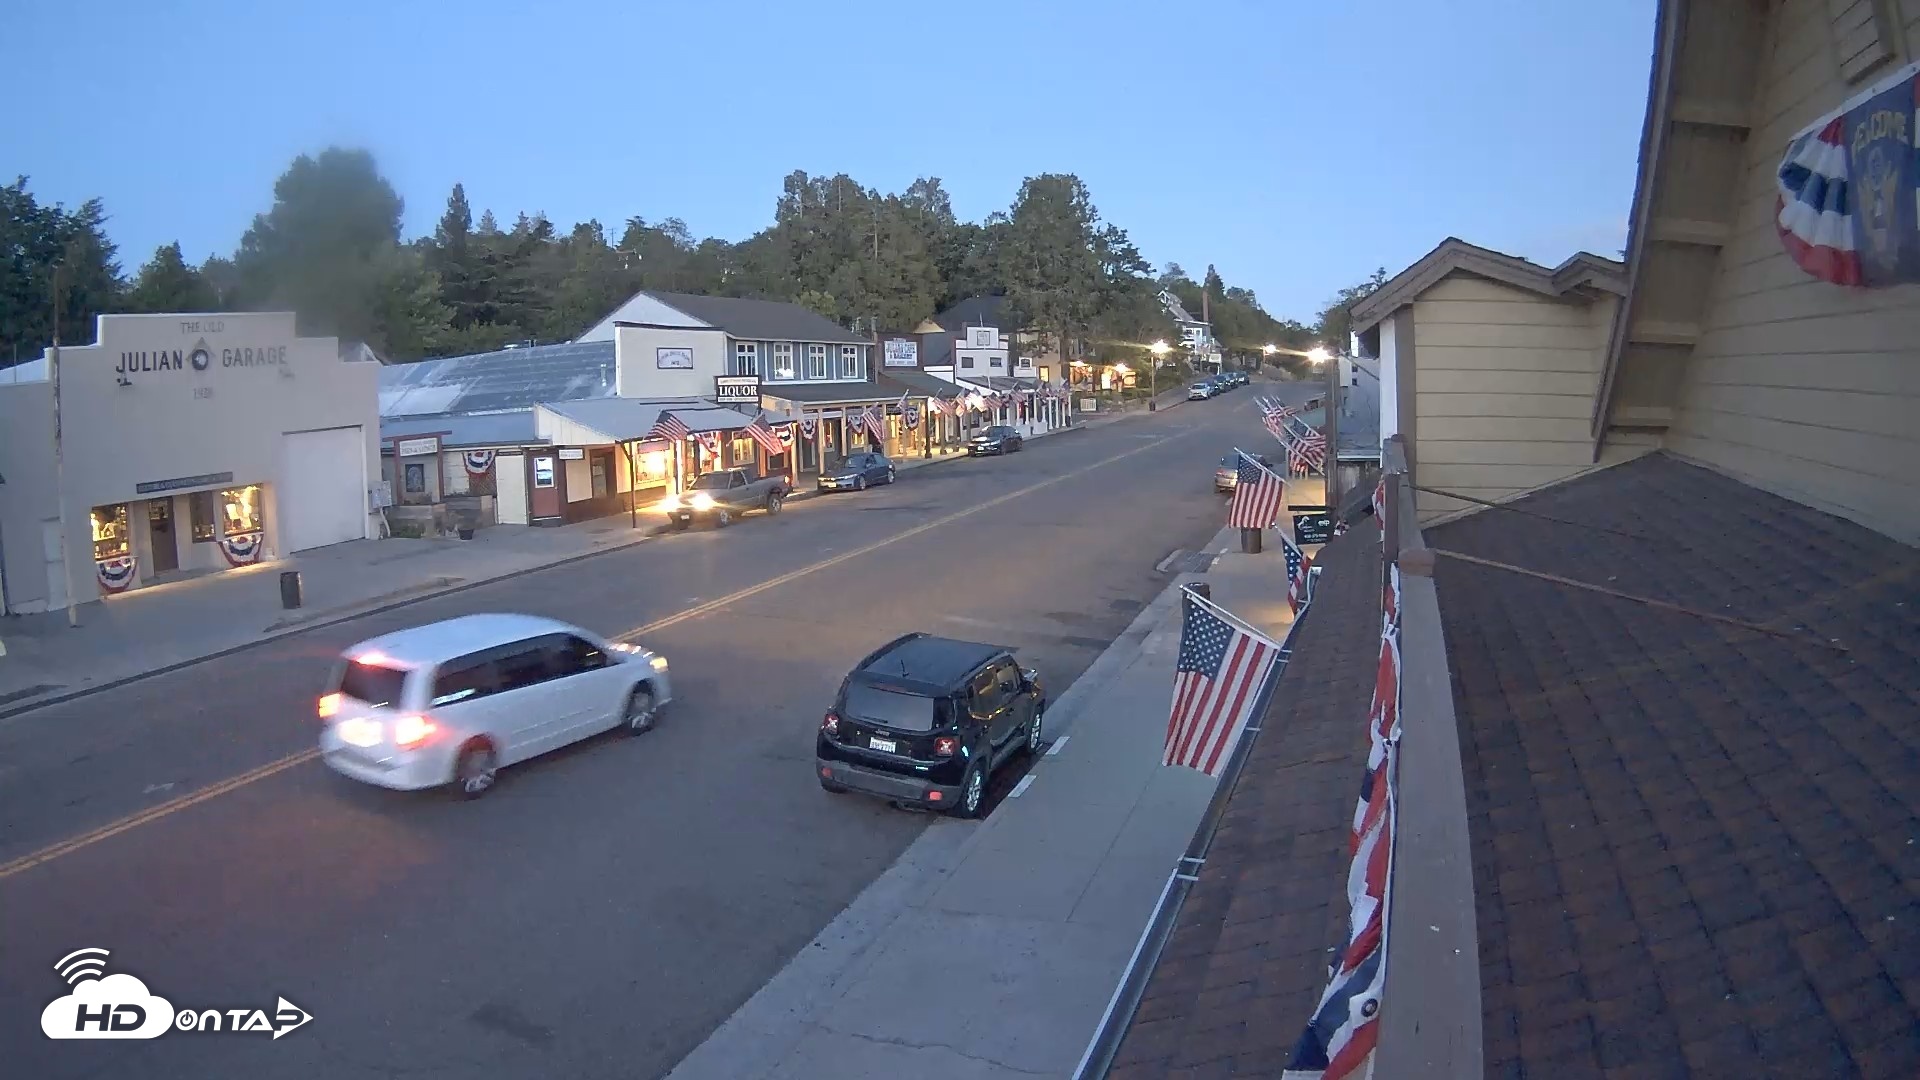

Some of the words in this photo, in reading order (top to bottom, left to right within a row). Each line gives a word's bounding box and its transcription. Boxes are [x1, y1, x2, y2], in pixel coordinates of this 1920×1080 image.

[180, 321, 200, 334] THE
[203, 321, 224, 333] OLD
[116, 350, 183, 373] JULIAN
[222, 345, 287, 368] GARAGE
[719, 385, 758, 397] LIQUOR
